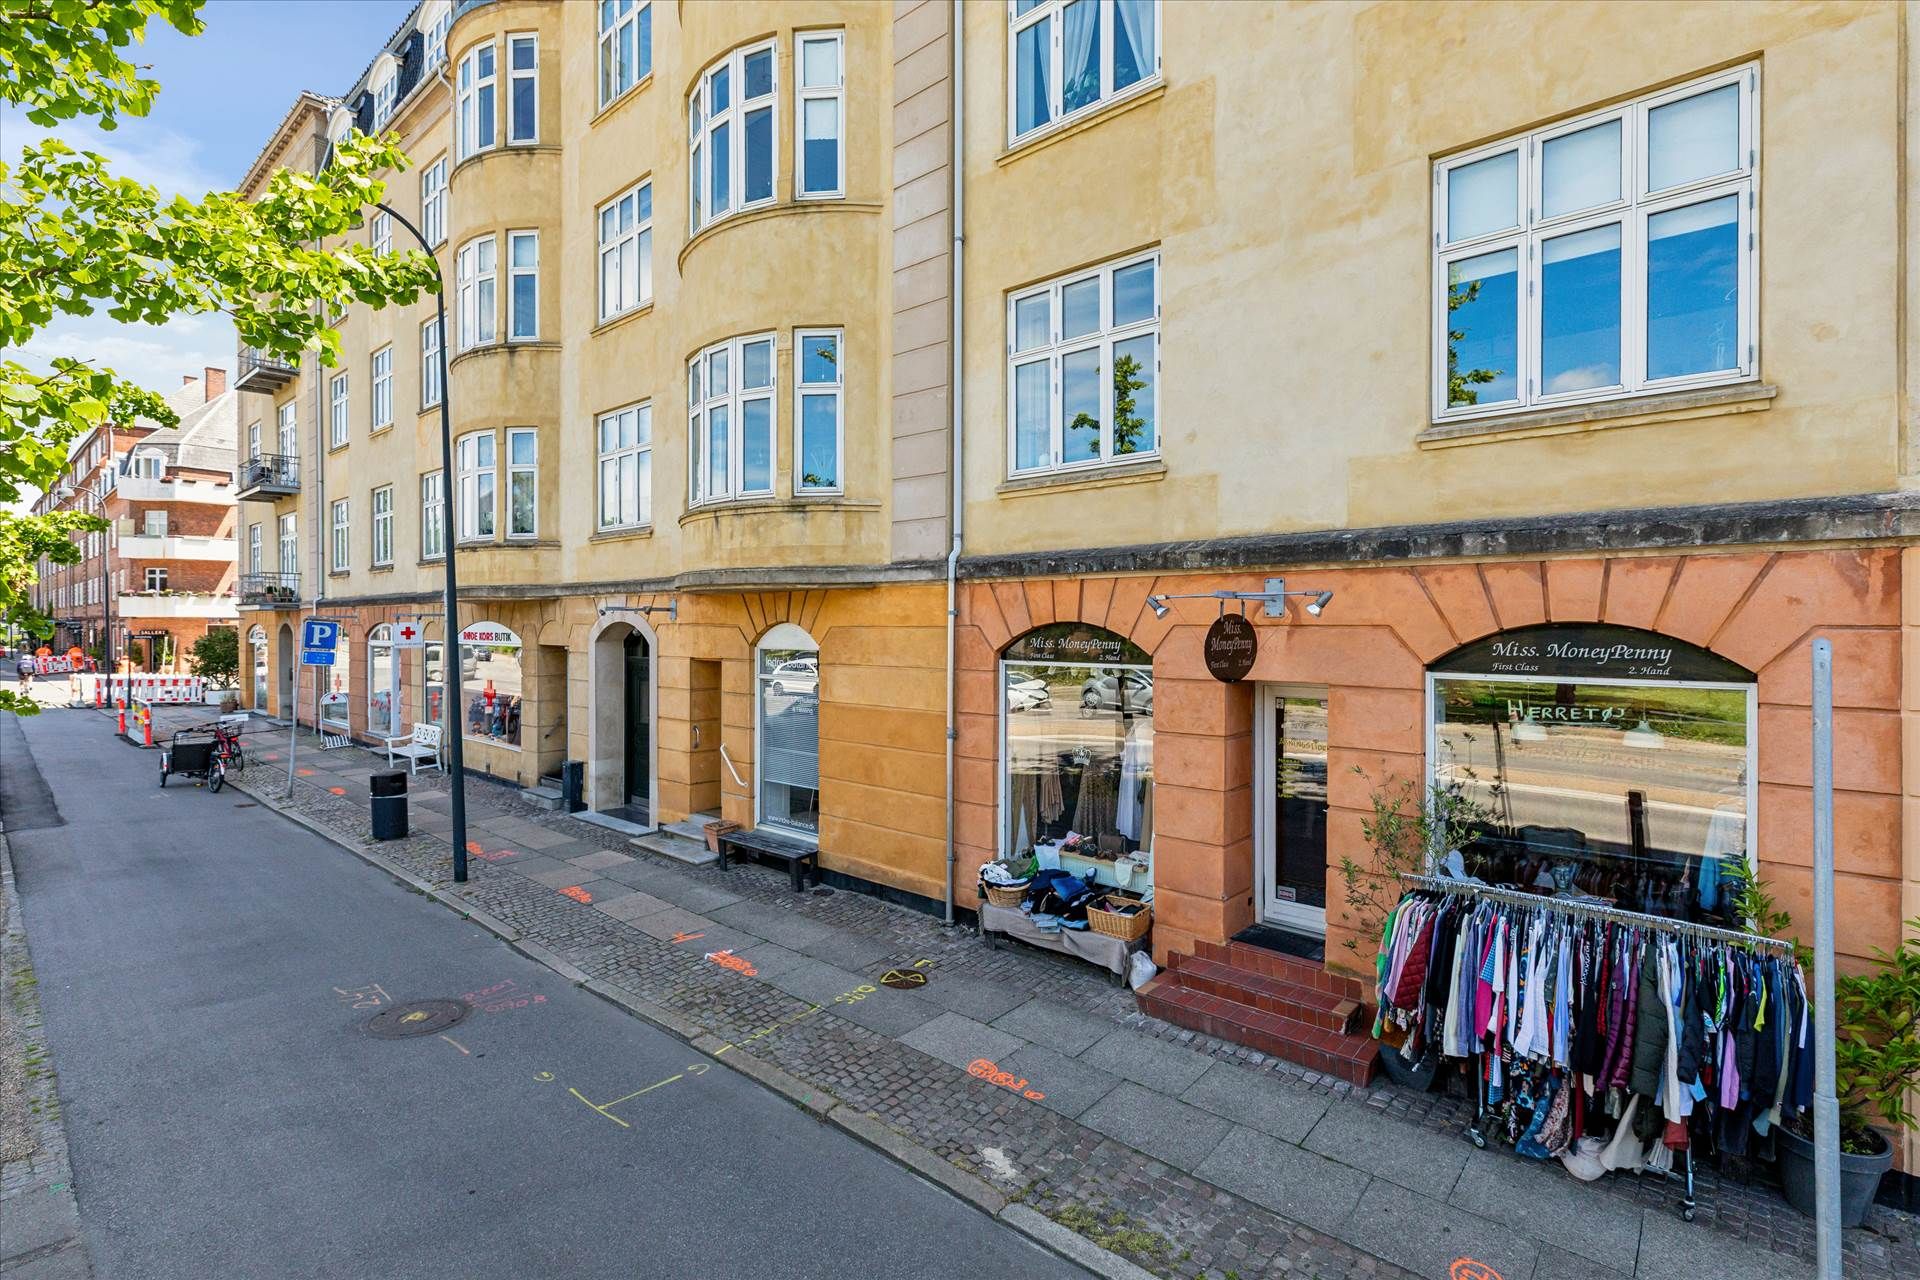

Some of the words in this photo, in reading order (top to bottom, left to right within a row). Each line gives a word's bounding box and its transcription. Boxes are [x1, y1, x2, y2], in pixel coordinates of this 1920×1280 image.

[310, 624, 332, 646] P
[463, 631, 478, 640] RØDE
[479, 631, 494, 641] KORS
[495, 632, 512, 642] BUTIK
[1029, 636, 1055, 648] Miss.
[1057, 637, 1121, 654] MoneyPenny
[1210, 635, 1253, 656] MoneyPenny
[1491, 640, 1540, 657] Miss.
[1546, 642, 1672, 666] MoneyPenny
[1491, 662, 1513, 672] First
[1514, 662, 1540, 672] Class
[1628, 666, 1638, 675] 2.
[1640, 666, 1672, 676] Hand
